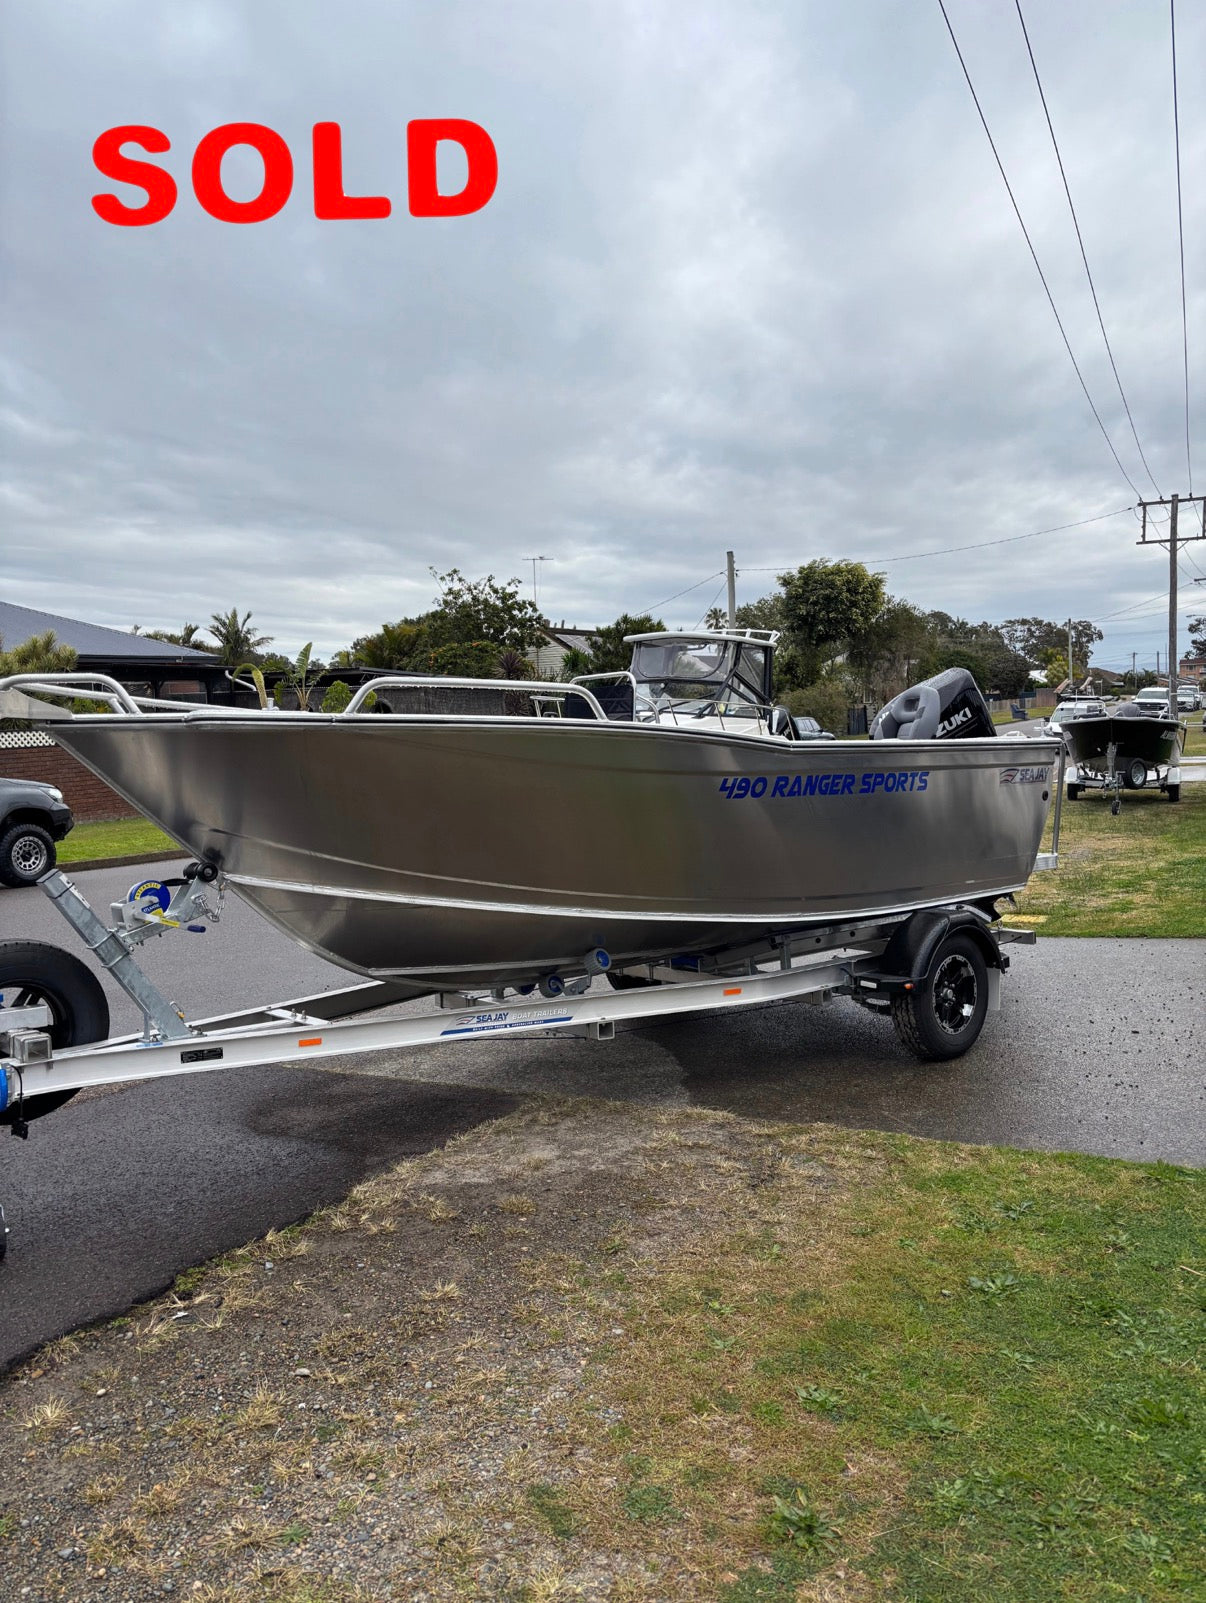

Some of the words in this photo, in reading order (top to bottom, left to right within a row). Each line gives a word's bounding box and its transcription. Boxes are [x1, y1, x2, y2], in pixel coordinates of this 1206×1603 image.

[936, 706, 972, 738] ZUKI
[718, 777, 768, 799] 490
[770, 774, 855, 797] RANGER
[858, 771, 930, 794] SPORTS
